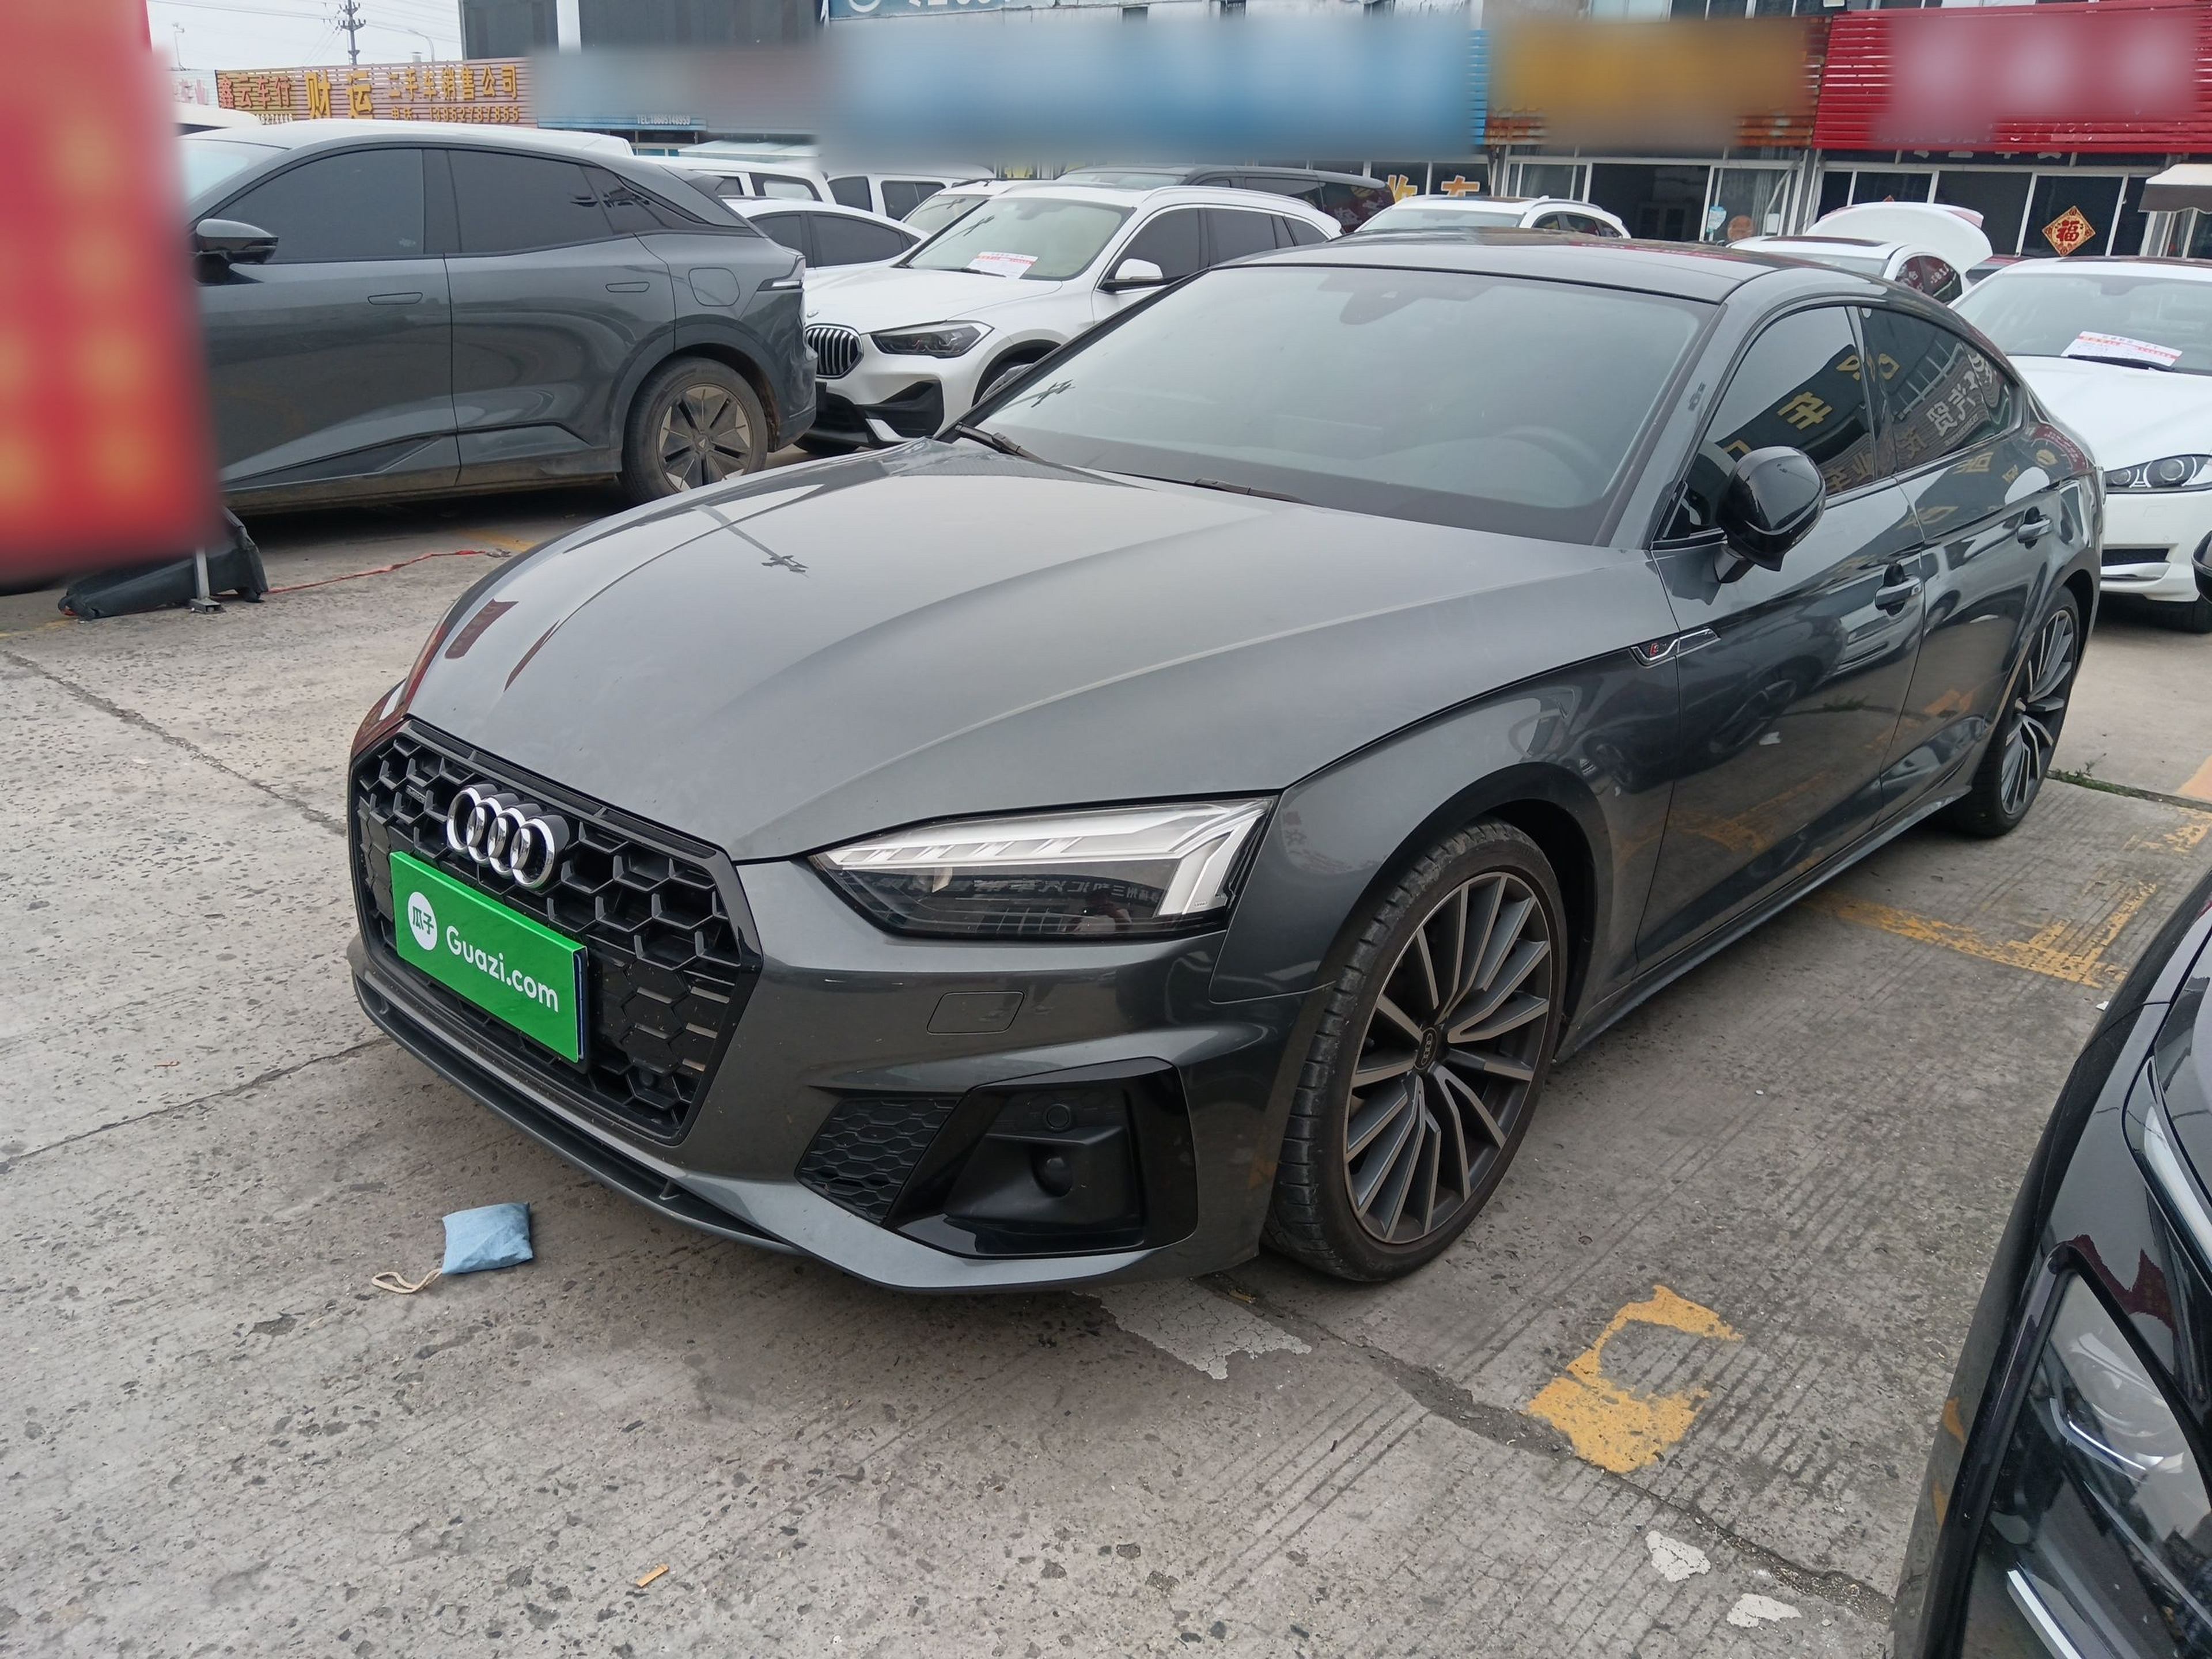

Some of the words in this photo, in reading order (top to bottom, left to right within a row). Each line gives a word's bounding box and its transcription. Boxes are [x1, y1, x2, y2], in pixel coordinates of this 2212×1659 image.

[305, 69, 374, 119] 财运
[388, 65, 517, 101] 二手车销售公司
[2056, 219, 2080, 242] 福
[411, 905, 434, 935] 瓜子
[446, 925, 559, 1013] Guazi.com
